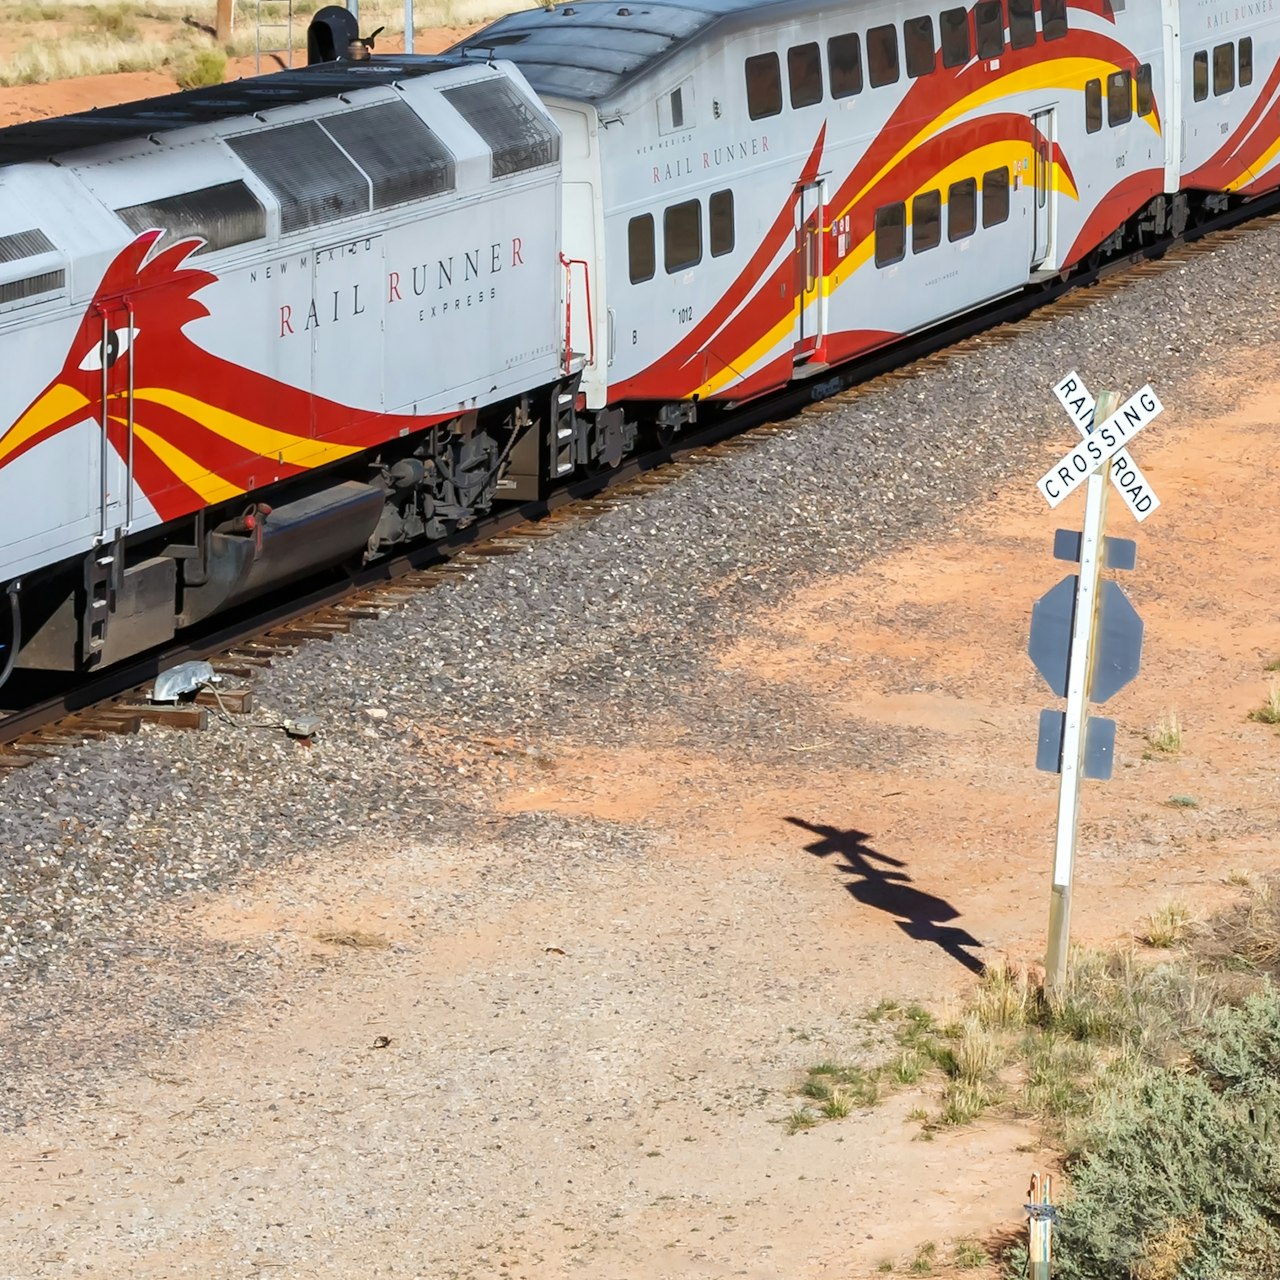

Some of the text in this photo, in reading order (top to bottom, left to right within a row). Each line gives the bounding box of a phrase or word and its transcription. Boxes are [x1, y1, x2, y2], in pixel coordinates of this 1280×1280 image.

[653, 136, 769, 183] RAIL RUNNER
[250, 239, 371, 283] NEW MEXICO
[279, 237, 524, 338] RAIL RUNNER
[419, 287, 496, 322] EXPRESS
[678, 306, 692, 325] 1012
[1045, 393, 1155, 498] CROSSING
[1112, 456, 1152, 513] ROAD
